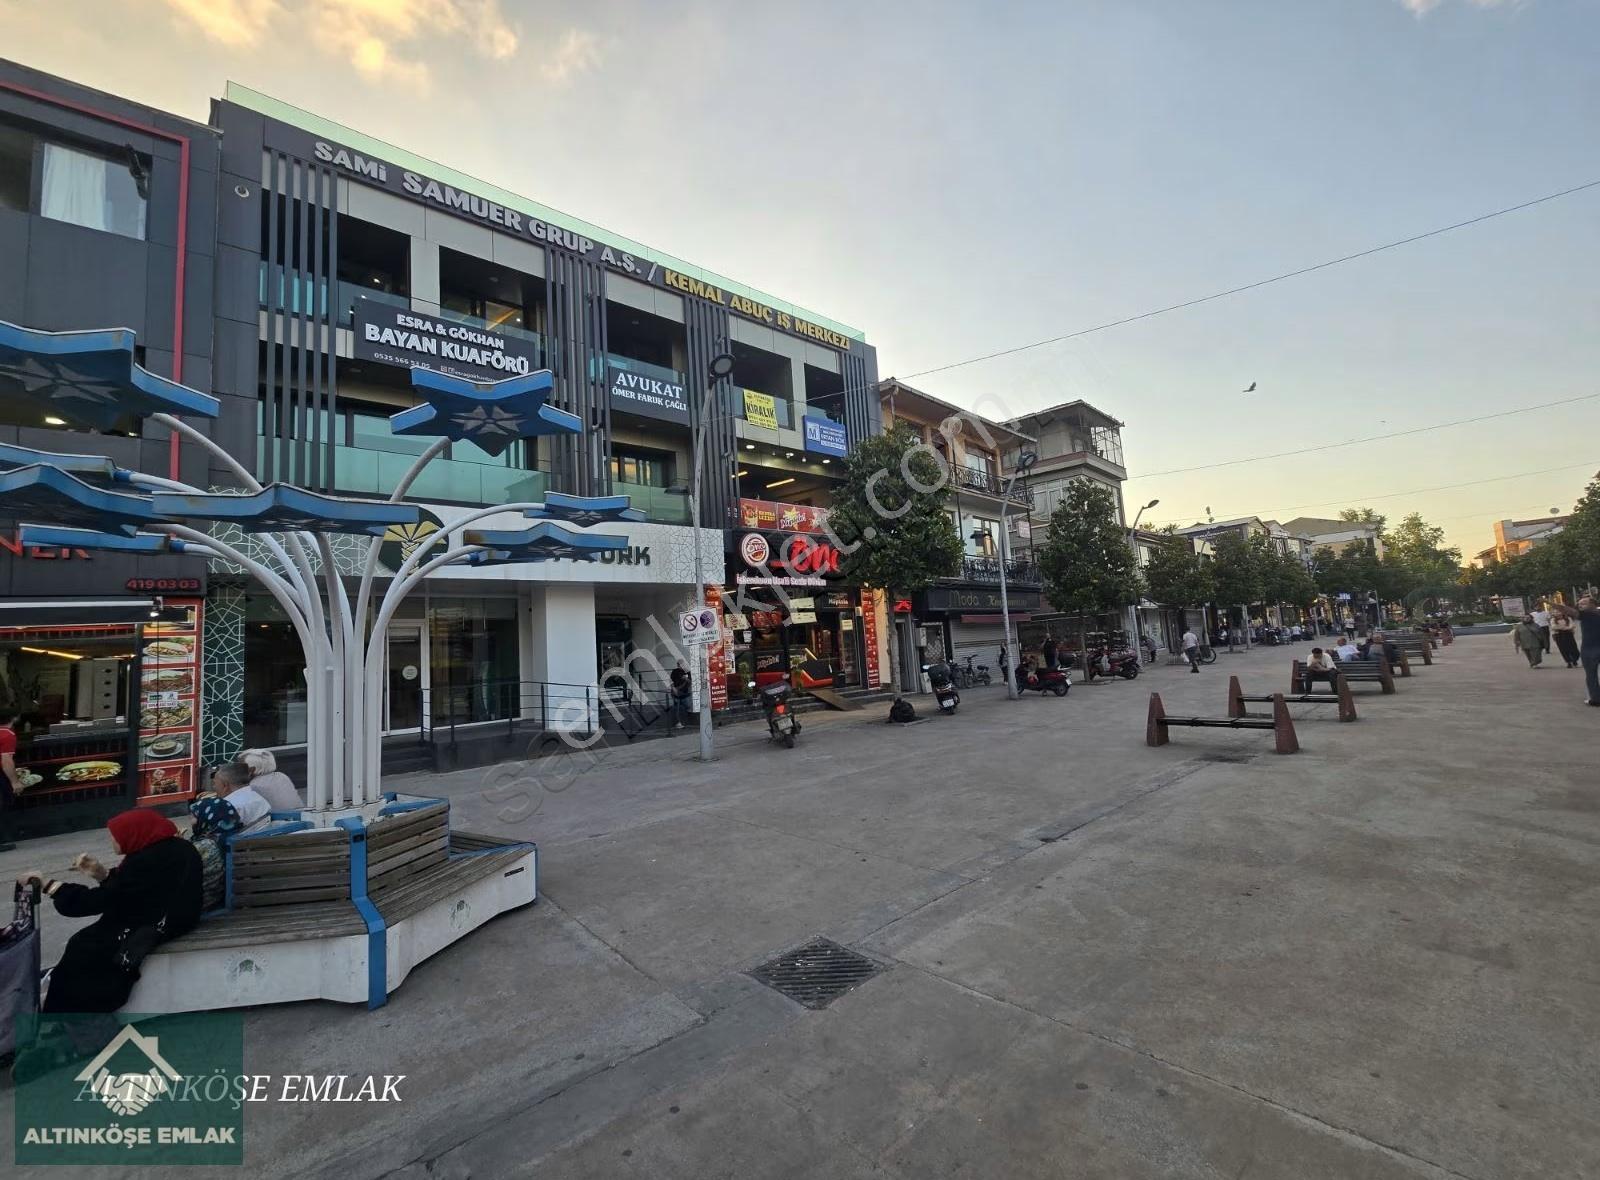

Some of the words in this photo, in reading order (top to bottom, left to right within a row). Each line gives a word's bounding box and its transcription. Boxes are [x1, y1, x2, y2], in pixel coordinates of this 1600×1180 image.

[402, 171, 522, 232] SAMUER
[528, 218, 594, 254] GRUP
[664, 268, 725, 305] KEMAL
[396, 313, 434, 334] ESRA
[435, 323, 447, 336] &
[448, 326, 505, 350] GÖKHAN
[364, 321, 437, 356] BAYAN
[441, 340, 529, 375] KUAFÖRÜ
[611, 385, 636, 399] ÖMER
[637, 392, 664, 406] FARUK
[615, 372, 683, 399] AVUKAT
[127, 578, 155, 590] 419
[157, 579, 177, 590] 03
[179, 578, 199, 590] 03
